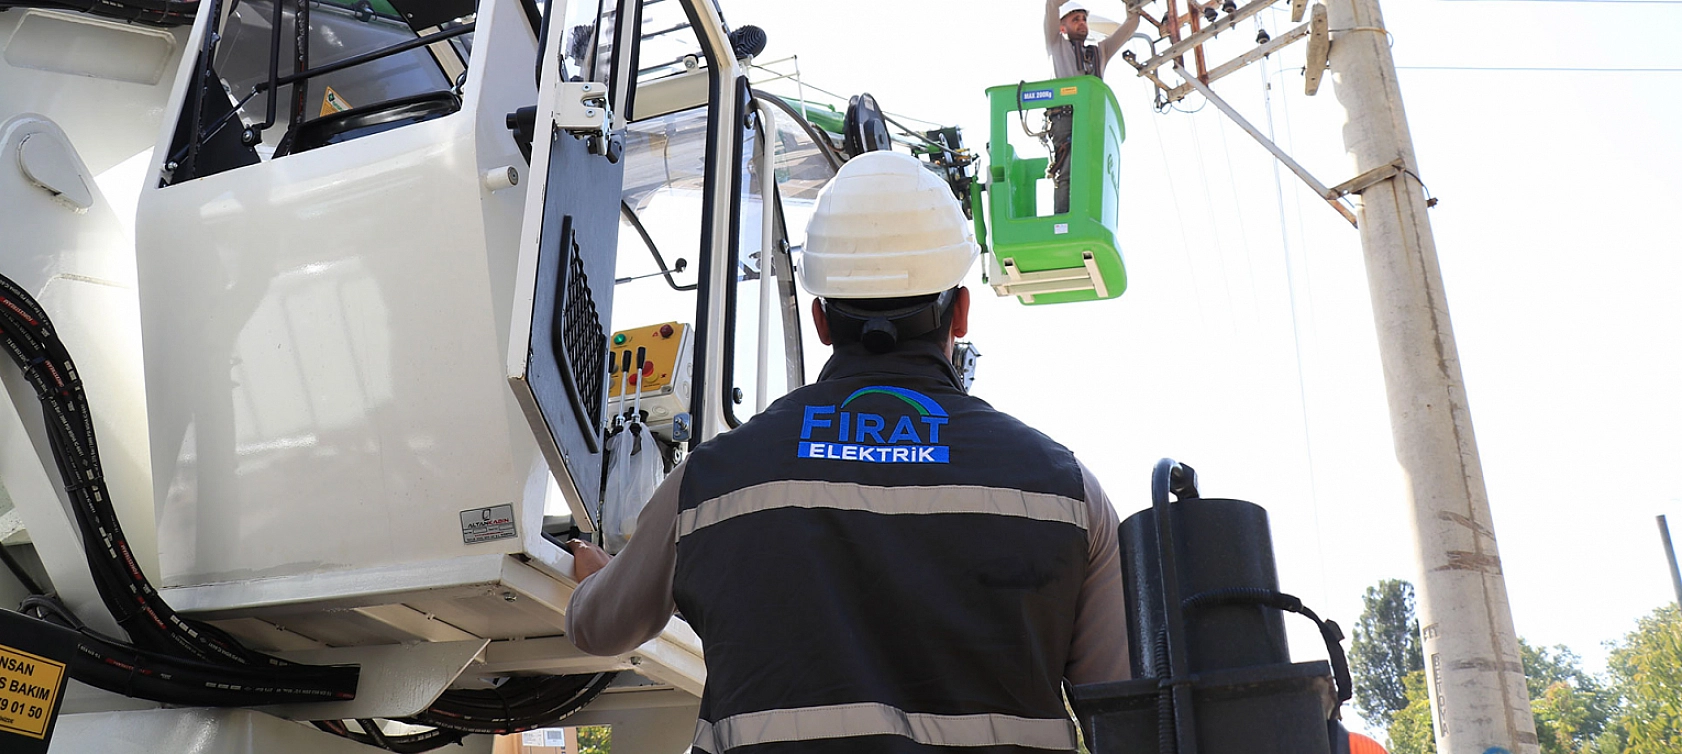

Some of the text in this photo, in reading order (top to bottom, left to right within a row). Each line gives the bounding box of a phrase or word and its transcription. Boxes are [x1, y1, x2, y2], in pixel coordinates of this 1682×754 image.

[1023, 92, 1035, 100] MAX
[800, 405, 949, 443] FIRAT
[0, 656, 35, 676] NSAN
[9, 680, 50, 700] BAKIM
[0, 697, 43, 719] 9 01 50
